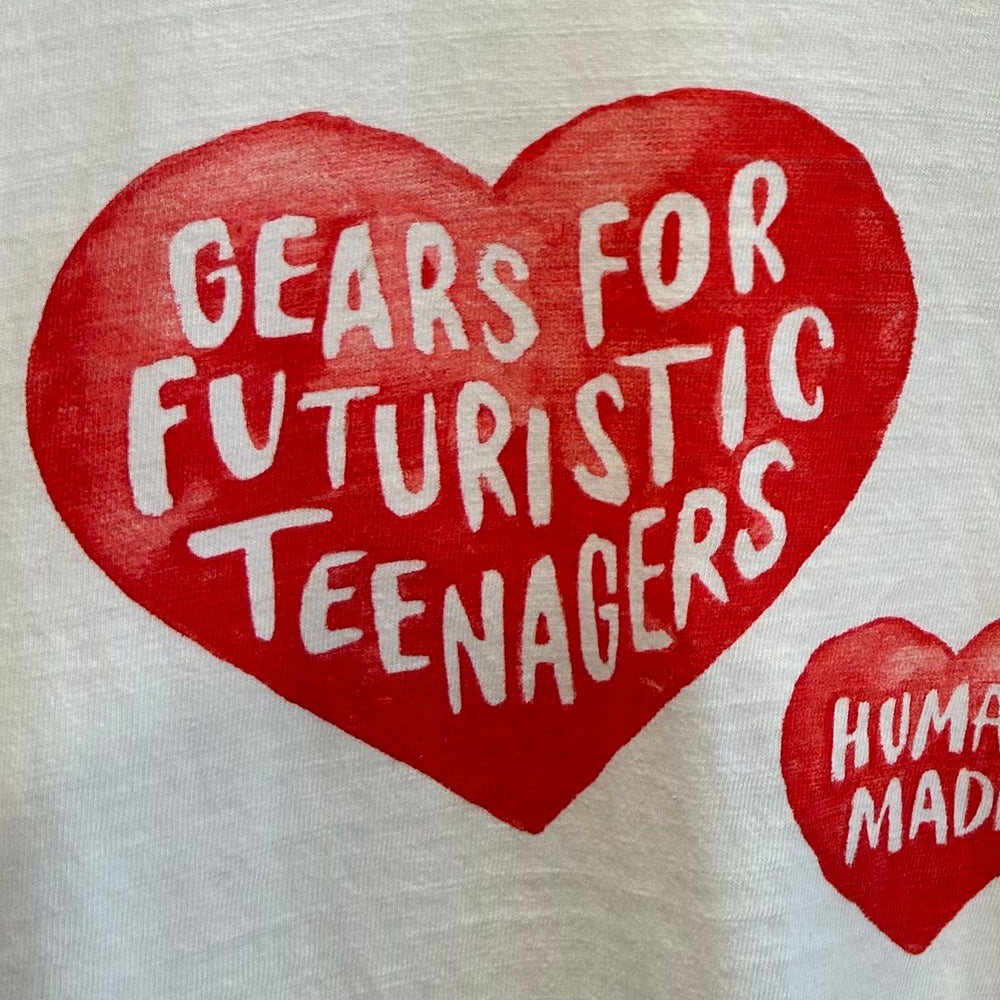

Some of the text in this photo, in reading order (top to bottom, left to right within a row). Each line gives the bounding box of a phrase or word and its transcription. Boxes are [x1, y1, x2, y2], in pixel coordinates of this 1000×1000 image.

[169, 160, 788, 363] GEARS FOR
[128, 305, 835, 532] FUTURISTIC
[188, 439, 795, 714] TEENAGERS
